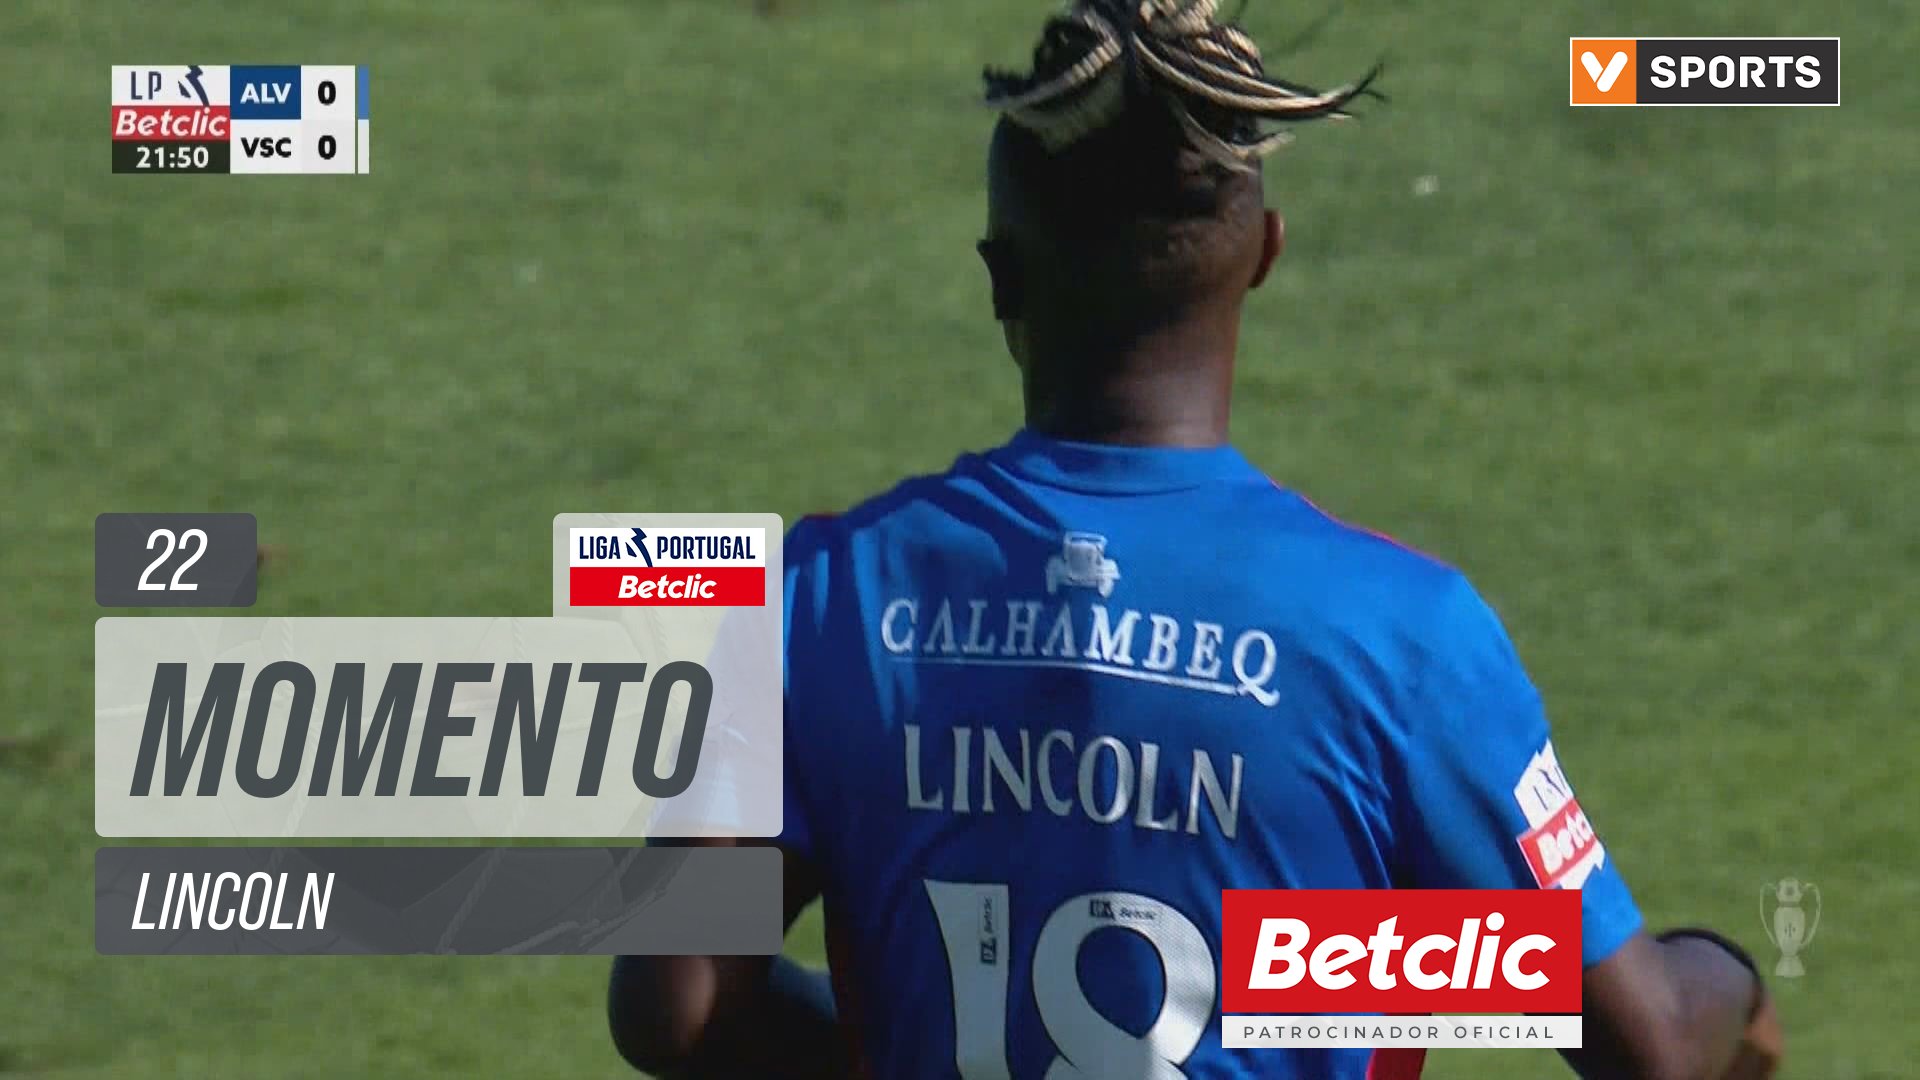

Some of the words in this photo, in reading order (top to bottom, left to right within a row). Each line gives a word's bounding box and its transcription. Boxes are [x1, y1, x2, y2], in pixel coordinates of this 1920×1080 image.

[880, 597, 1281, 708] CALHAMBEQ
[903, 722, 1245, 841] LINCOLN
[922, 879, 1217, 1080] 18
